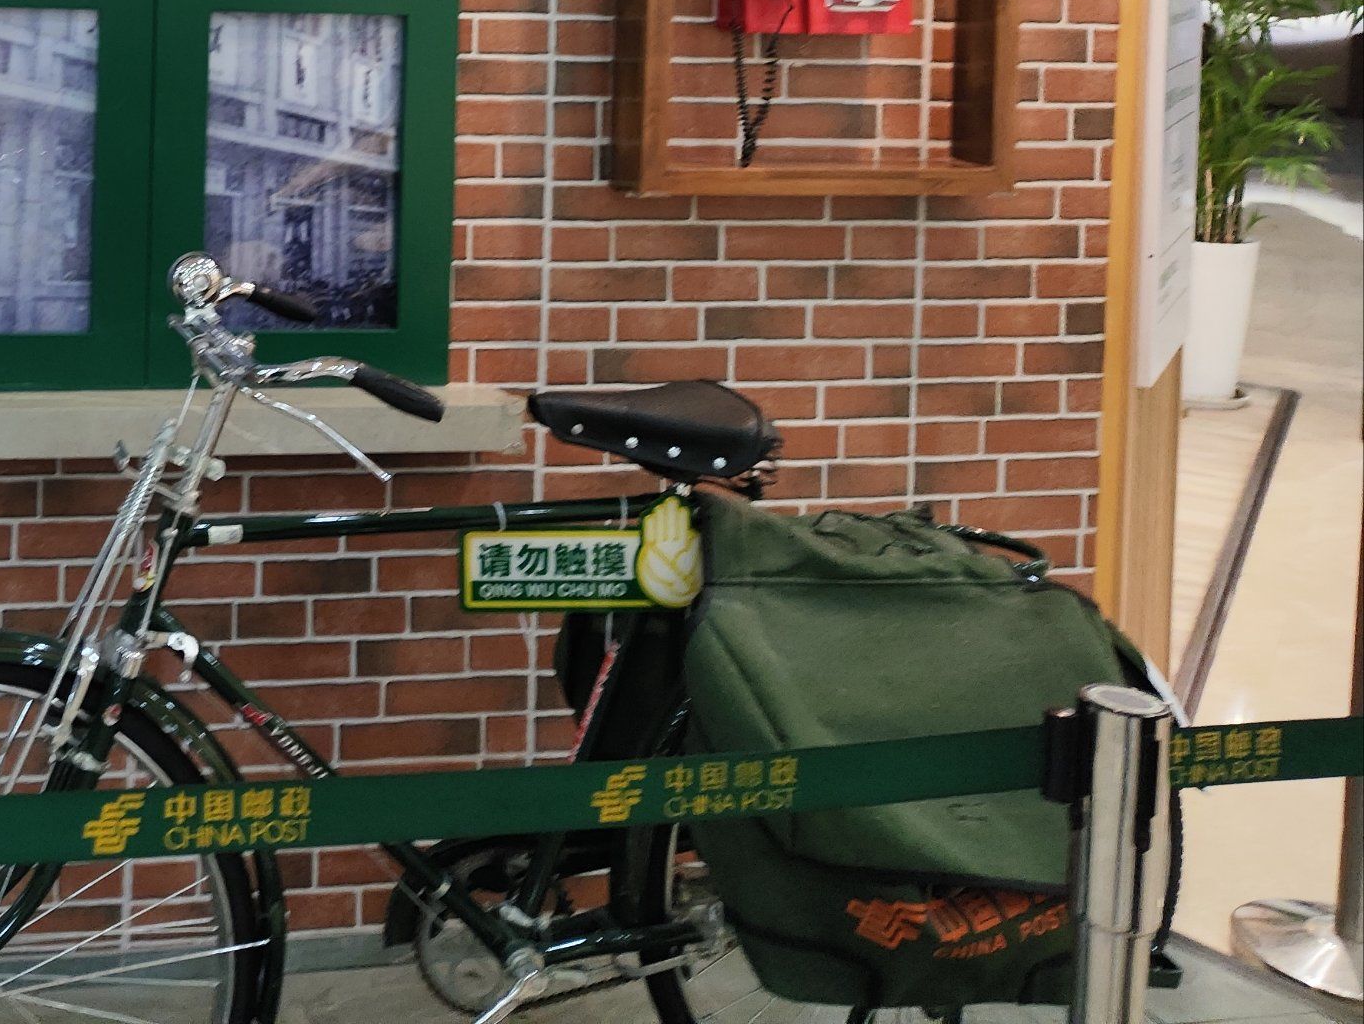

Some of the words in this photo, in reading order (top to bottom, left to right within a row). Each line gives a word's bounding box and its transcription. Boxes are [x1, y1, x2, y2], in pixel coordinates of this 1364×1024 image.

[478, 542, 627, 578] 请勿触摸
[478, 582, 524, 600] QING
[525, 582, 555, 598] WU
[556, 582, 596, 598] CHU
[597, 582, 628, 598] MO
[163, 786, 313, 825] 中国邮政
[248, 818, 313, 845] POST
